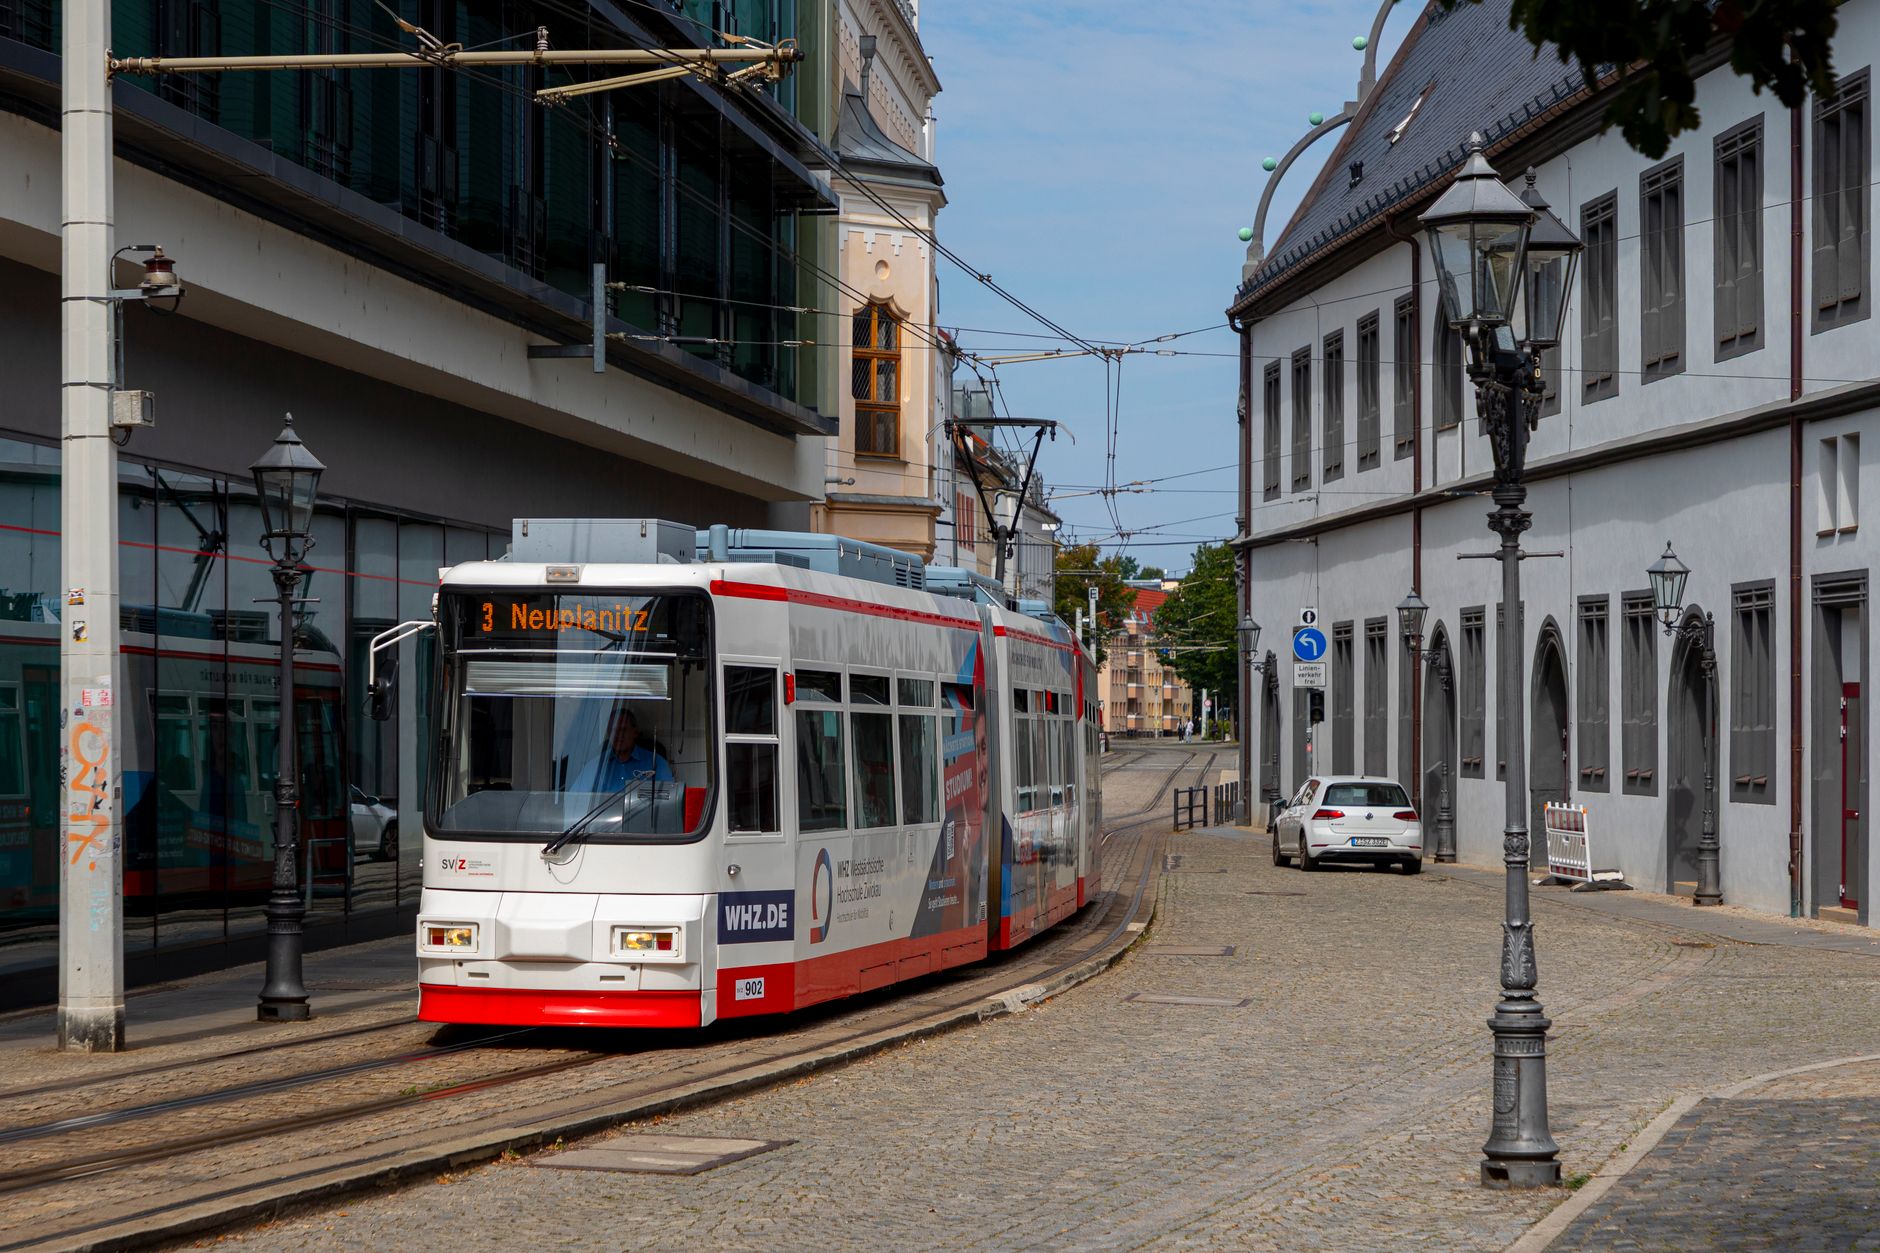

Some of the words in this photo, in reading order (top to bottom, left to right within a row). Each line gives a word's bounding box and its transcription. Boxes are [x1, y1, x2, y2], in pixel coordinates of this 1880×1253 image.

[481, 602, 494, 632] 3
[511, 602, 649, 632] Neuplanitz
[724, 903, 788, 932] WHZ.DE
[745, 980, 763, 996] 902
